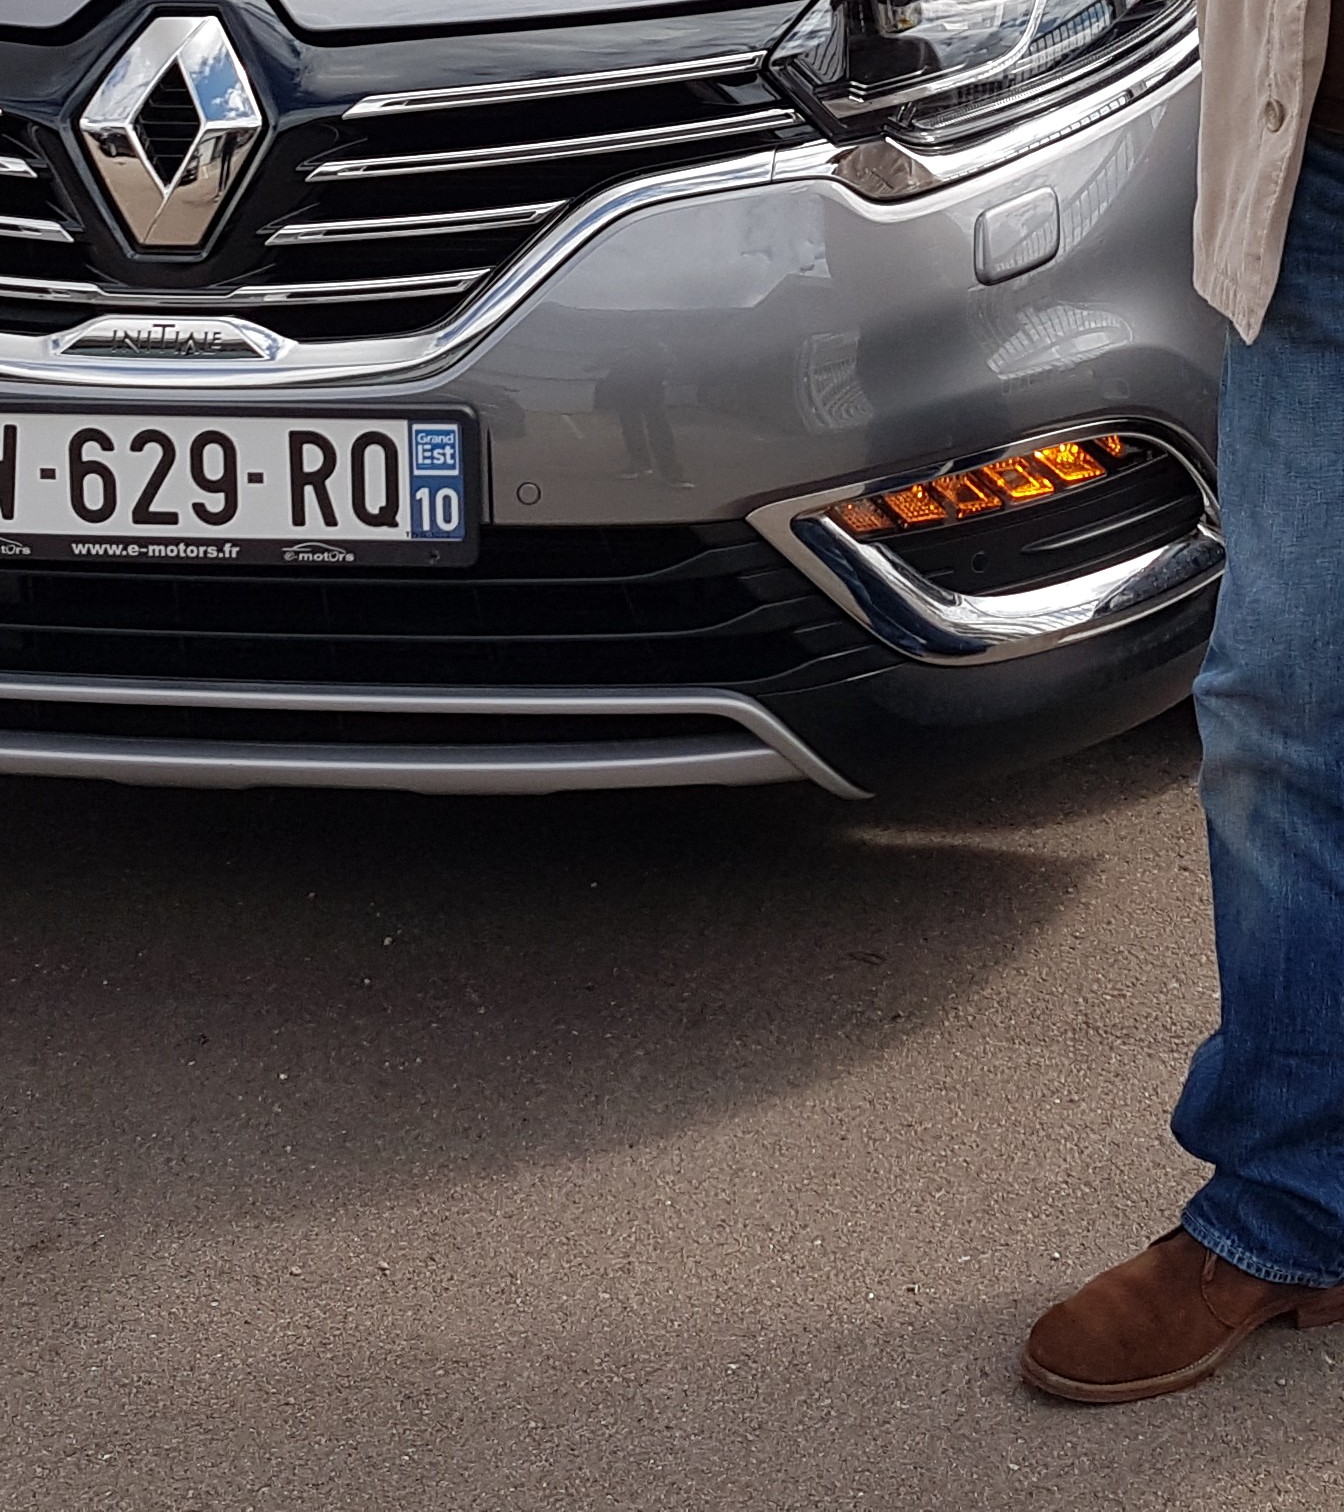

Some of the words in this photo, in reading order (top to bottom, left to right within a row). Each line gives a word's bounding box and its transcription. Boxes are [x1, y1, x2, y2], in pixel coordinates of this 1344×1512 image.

[416, 432, 455, 444] Grand
[417, 444, 455, 465] Est
[415, 487, 460, 532] 10
[71, 542, 241, 559] www.e-motors.fr
